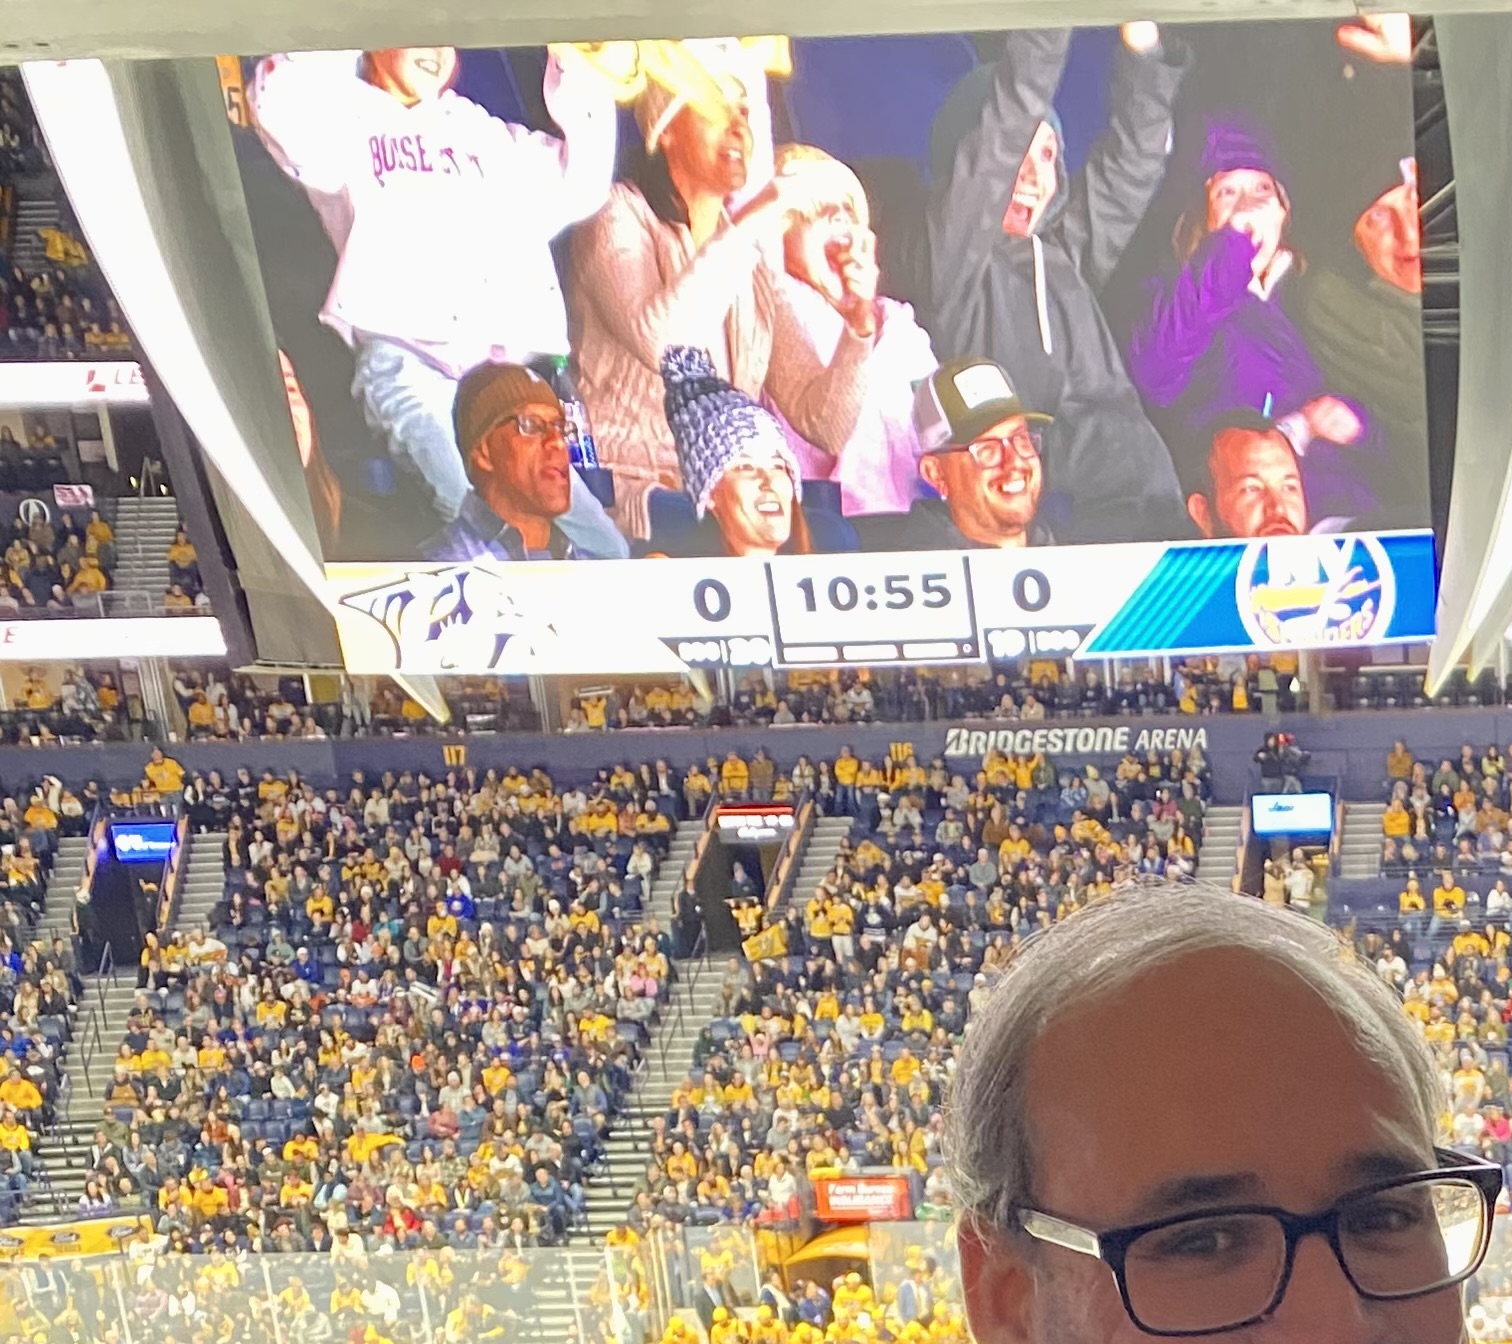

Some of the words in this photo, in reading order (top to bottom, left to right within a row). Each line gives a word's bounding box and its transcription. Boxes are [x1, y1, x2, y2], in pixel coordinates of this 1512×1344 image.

[693, 578, 731, 622] 0
[796, 572, 952, 612] 10:55
[1012, 568, 1051, 612] 0
[943, 727, 1129, 756] BRIDGESTONE
[1134, 728, 1208, 750] ARENA
